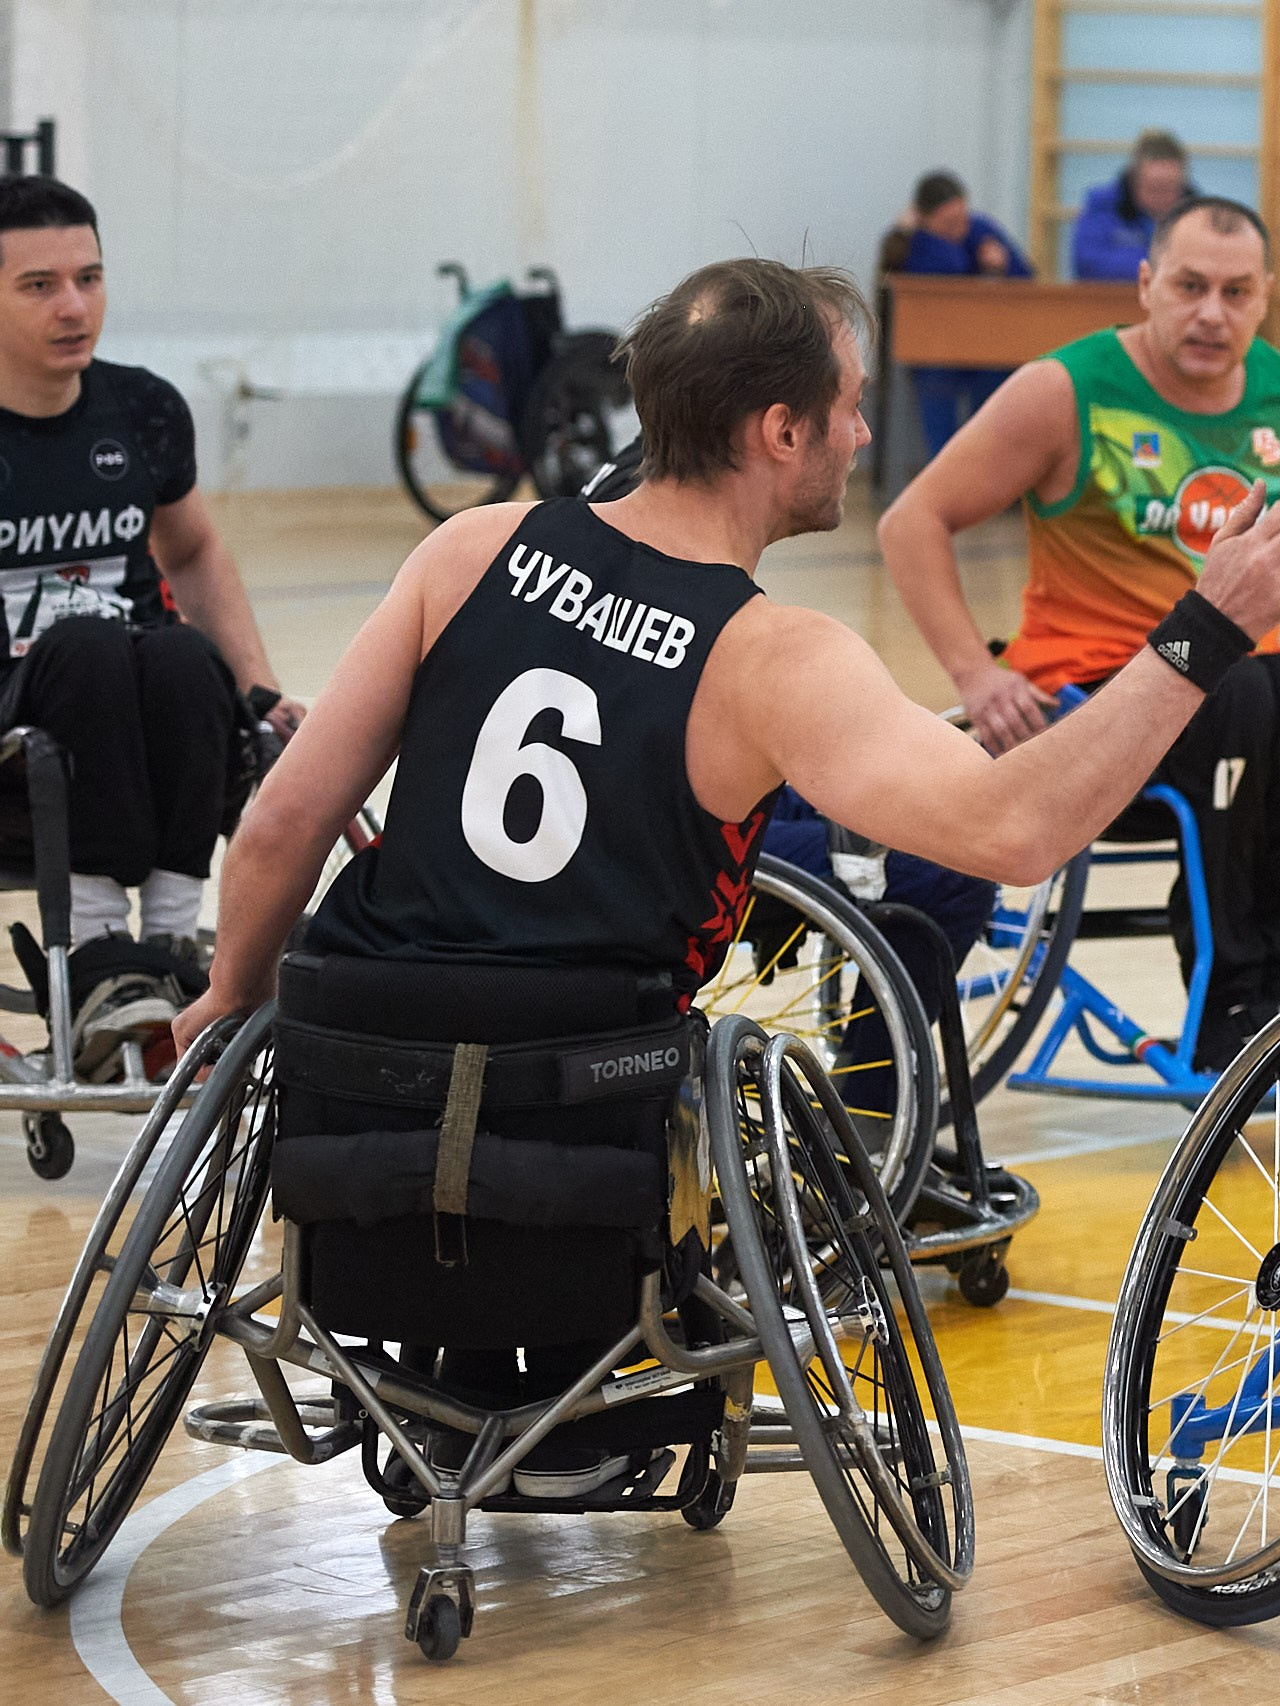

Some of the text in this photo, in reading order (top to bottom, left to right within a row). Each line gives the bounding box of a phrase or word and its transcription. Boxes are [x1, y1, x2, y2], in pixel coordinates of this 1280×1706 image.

[507, 543, 696, 670] ЧУВАШЕВ
[1157, 643, 1190, 673] adidas
[461, 667, 602, 883] 6
[590, 1046, 680, 1084] TORNEO
